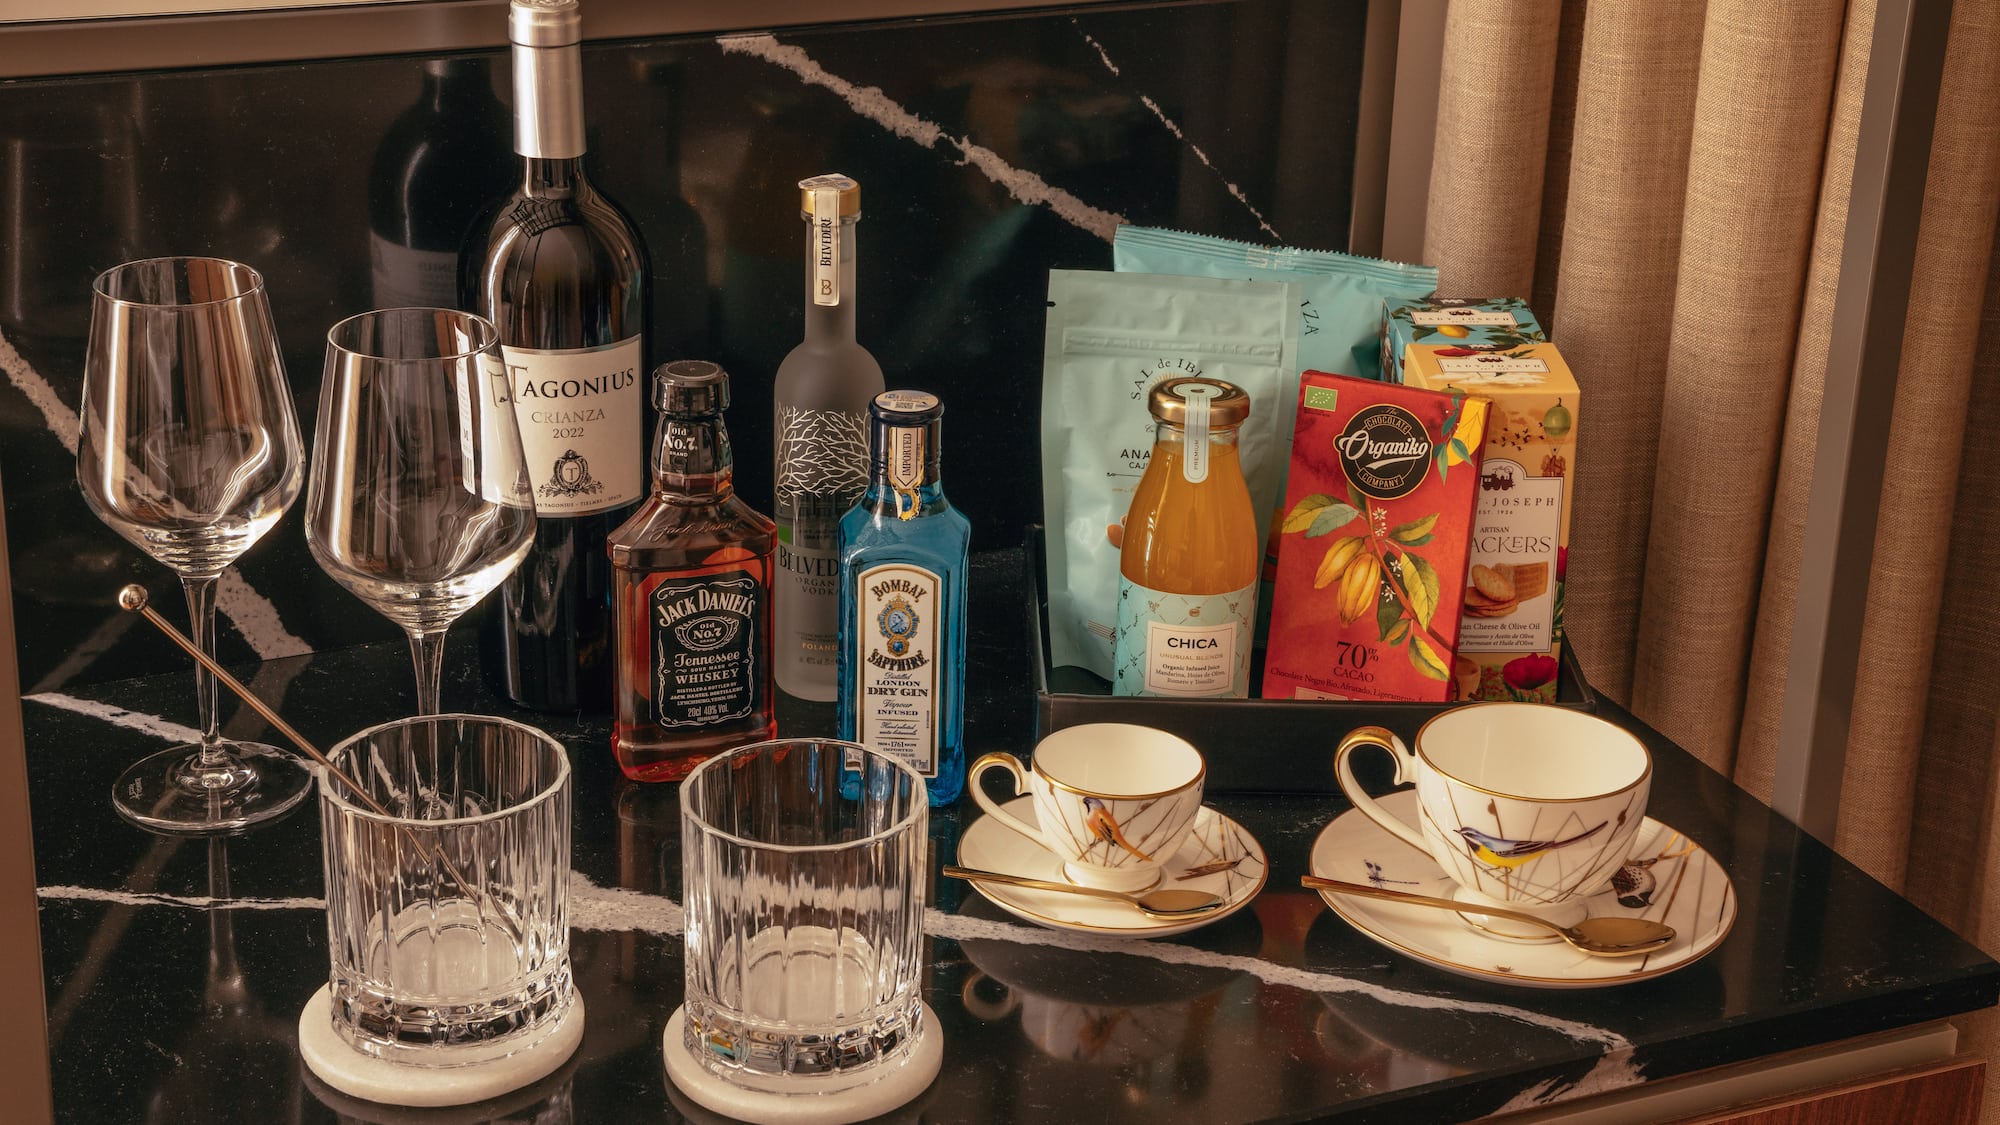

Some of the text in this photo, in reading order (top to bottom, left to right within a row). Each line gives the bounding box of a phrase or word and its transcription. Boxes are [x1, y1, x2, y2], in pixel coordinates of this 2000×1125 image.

[820, 216, 832, 266] BELVEDERE
[505, 364, 634, 404] TAGONIUS
[1130, 367, 1154, 401] SAL
[1157, 357, 1171, 370] de
[531, 408, 606, 424] CRIANZA
[1366, 415, 1410, 433] CHOCOLATE
[552, 427, 585, 439] 2022
[1338, 429, 1429, 461] Organiko
[902, 433, 912, 476] IMPORTED
[1361, 472, 1400, 489] COMPANY
[1491, 497, 1555, 507] JOSEPH
[1480, 526, 1510, 534] ARTISAN
[871, 579, 928, 603] BOMBAY
[656, 588, 756, 627] JACK DANIEL'S
[1473, 622, 1499, 630] Cheese
[1508, 622, 1527, 630] Olive
[1528, 622, 1540, 630] Oil
[1167, 637, 1218, 649] CHICA
[674, 650, 740, 668] Tennessee
[1159, 652, 1194, 661] UNUSUAL
[675, 667, 740, 685] WHISKEY
[1270, 667, 1304, 681] Chocolate
[1333, 666, 1375, 683] CACAO
[876, 679, 920, 687] LONDON
[867, 687, 929, 697] DRY GIN
[703, 704, 718, 715] 40%
